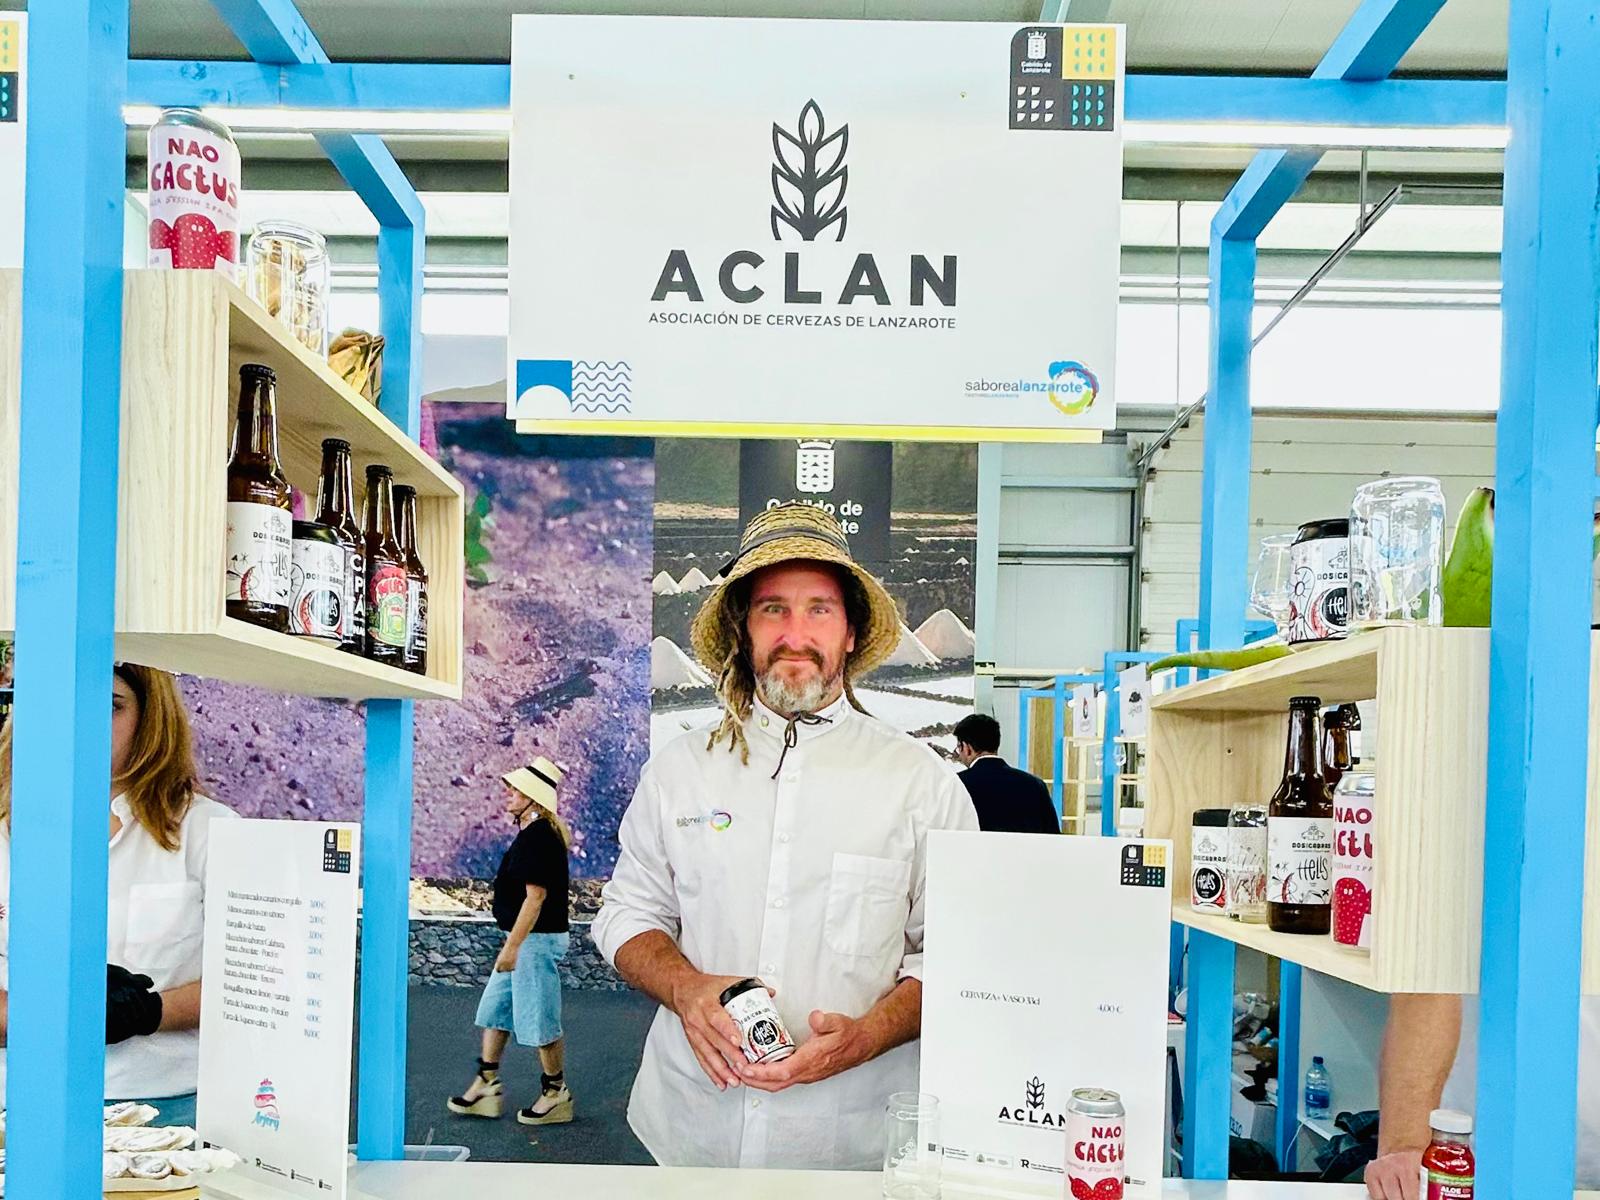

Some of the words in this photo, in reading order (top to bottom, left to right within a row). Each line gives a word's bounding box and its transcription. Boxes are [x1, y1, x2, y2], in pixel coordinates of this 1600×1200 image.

[168, 138, 219, 163] NAO
[650, 249, 958, 307] ACLAN
[649, 311, 738, 326] ASOCIACIÓN
[743, 313, 761, 326] DE
[766, 314, 841, 328] CERVEZAS
[846, 315, 865, 328] DE
[869, 315, 956, 330] LANZAROTE
[840, 500, 863, 516] de
[1334, 807, 1372, 824] NAO
[998, 1106, 1066, 1127] ACLAN
[1091, 1126, 1122, 1139] NAO
[1441, 1185, 1462, 1195] ALOE
